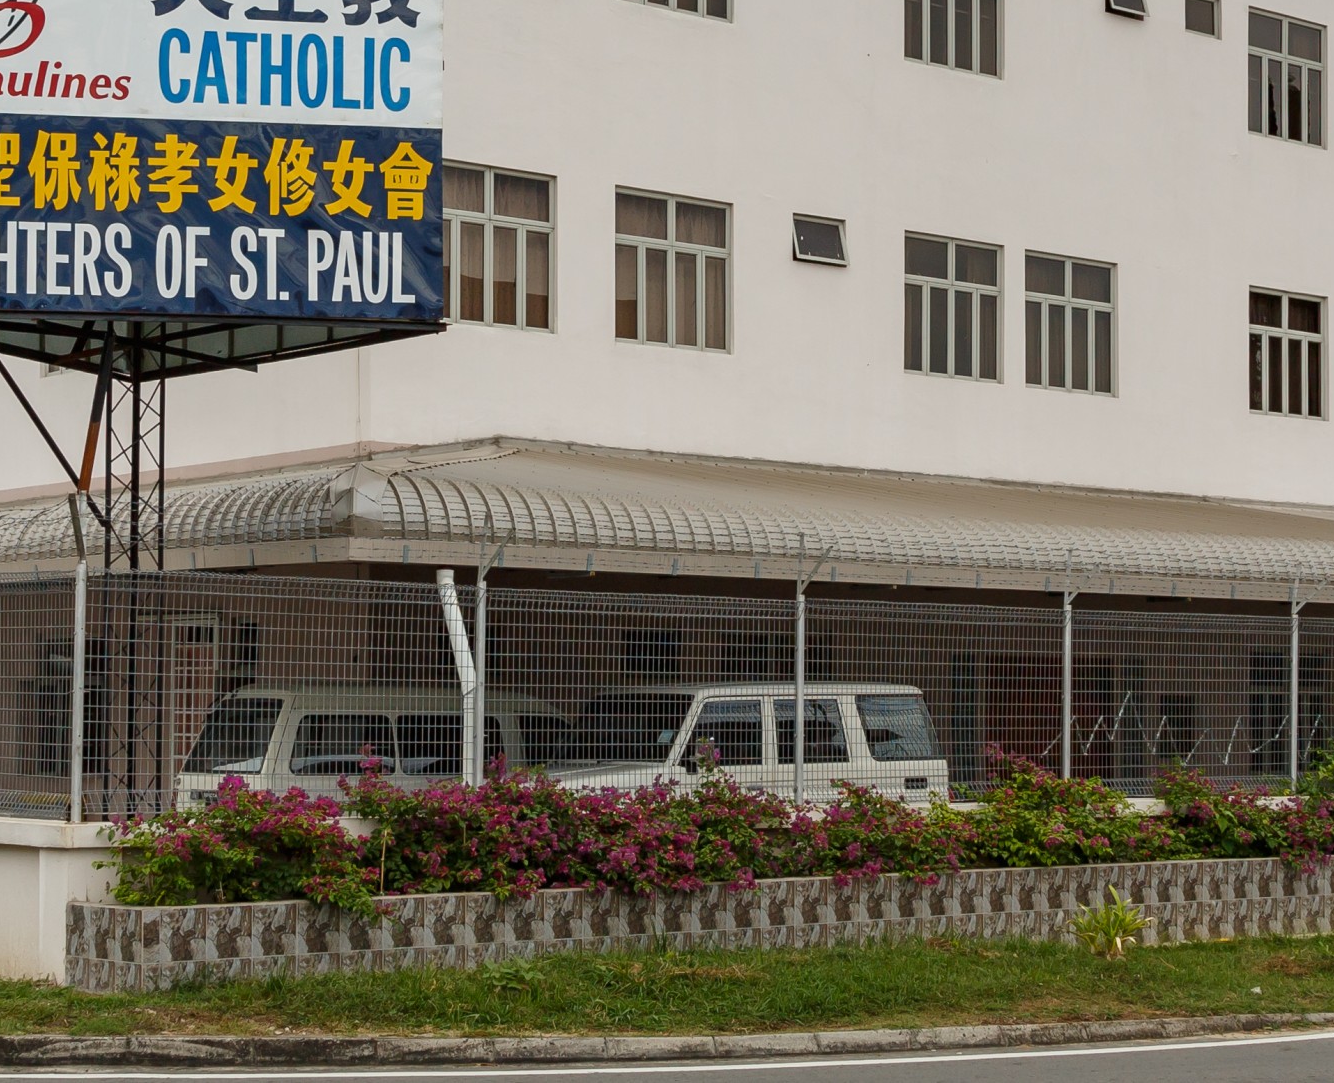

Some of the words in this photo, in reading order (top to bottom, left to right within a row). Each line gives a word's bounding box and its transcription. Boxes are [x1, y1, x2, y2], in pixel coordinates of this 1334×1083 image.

[158, 28, 411, 112] CATHOLIC
[155, 225, 211, 299] OF
[229, 226, 289, 301] ST.
[307, 230, 416, 304] PAUL
